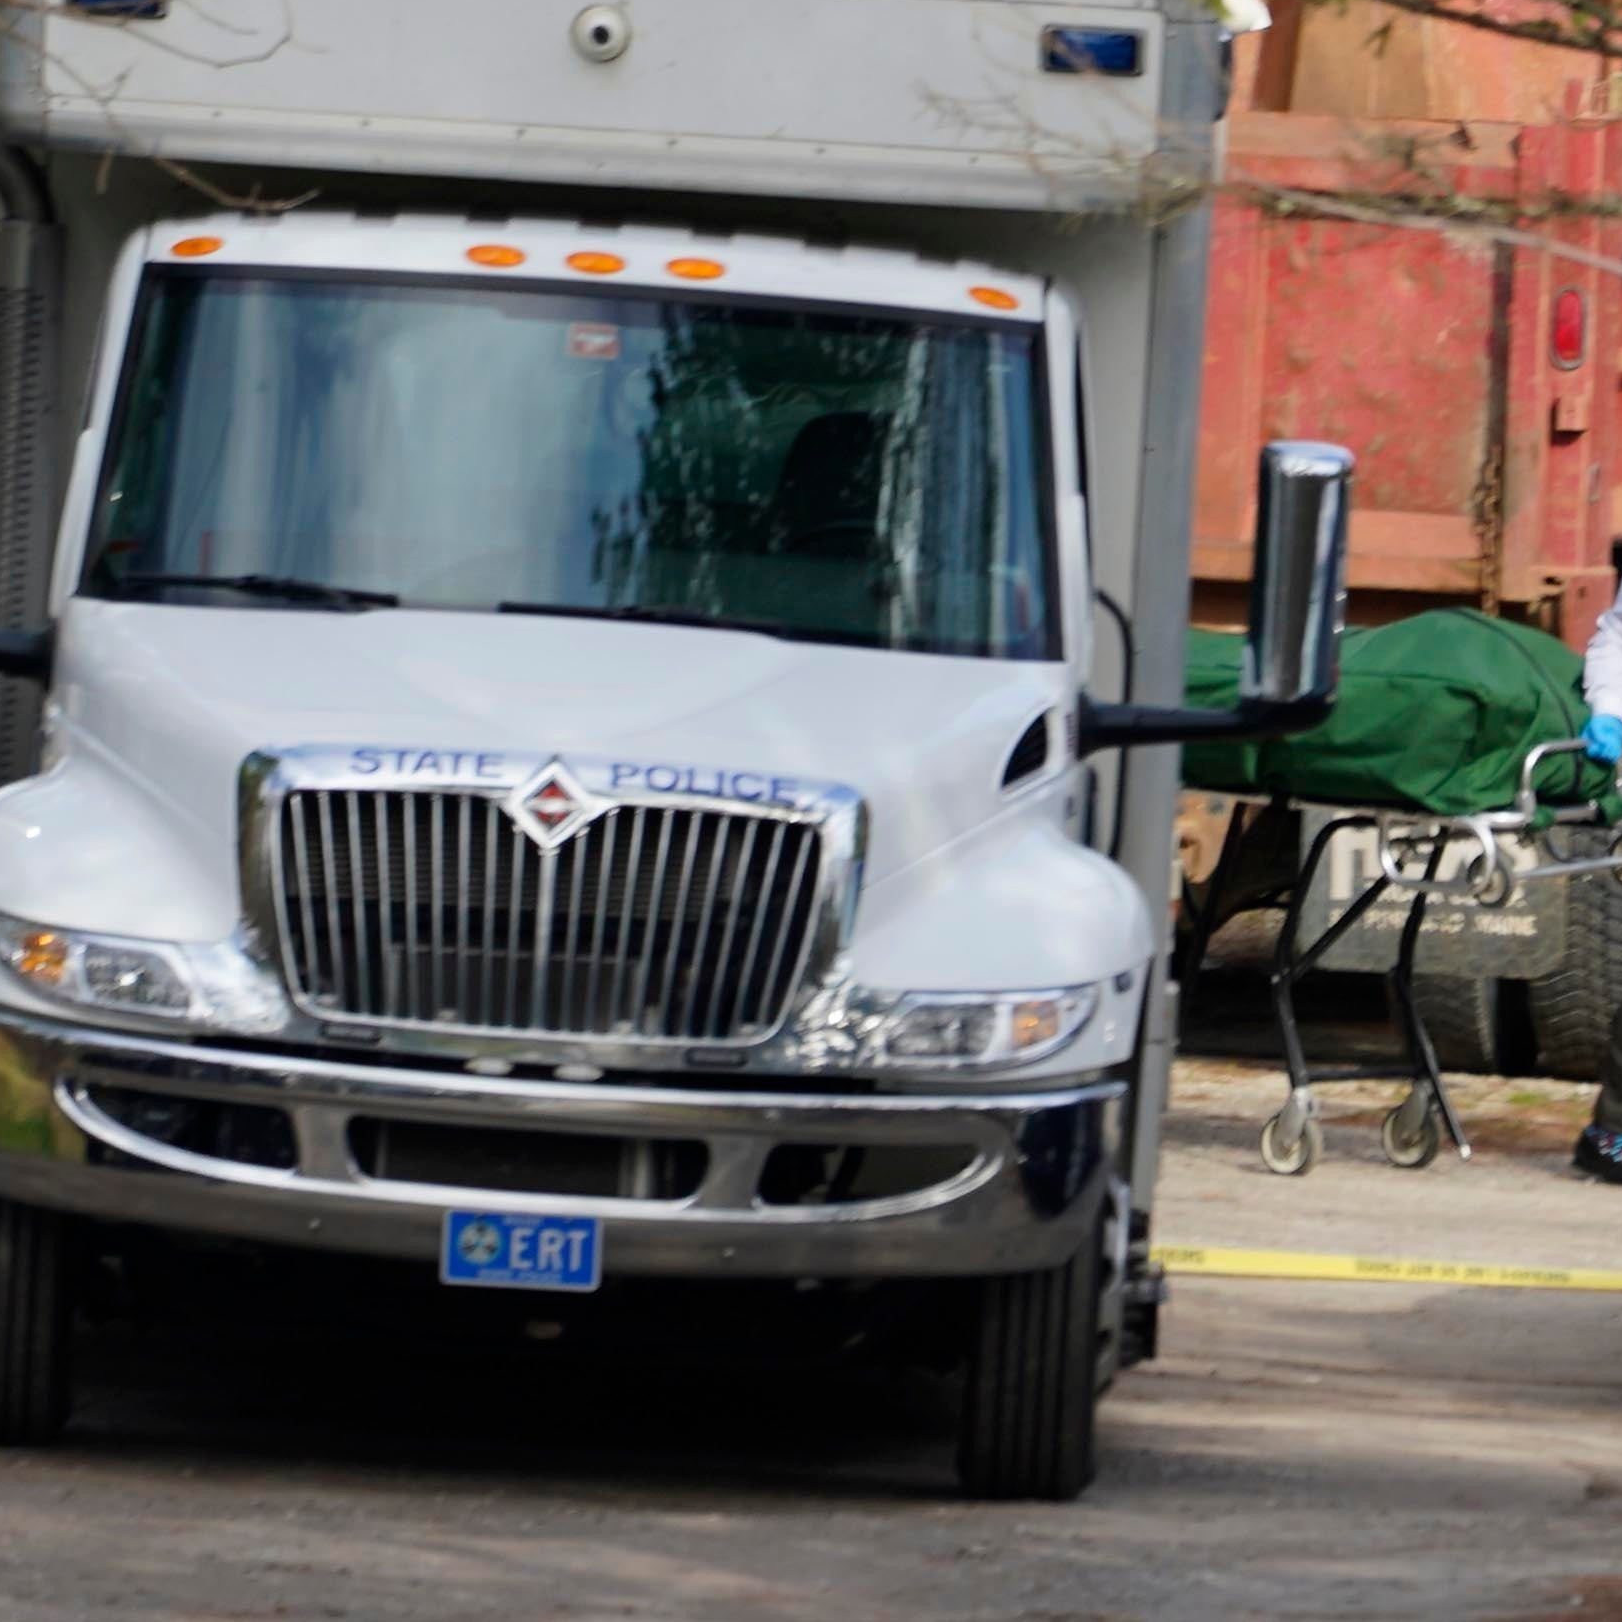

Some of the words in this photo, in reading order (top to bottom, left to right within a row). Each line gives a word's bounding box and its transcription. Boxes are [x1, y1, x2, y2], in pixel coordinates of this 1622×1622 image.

[350, 748, 505, 778] STATE
[610, 761, 799, 806] POLICE
[509, 1227, 589, 1273] ERT
